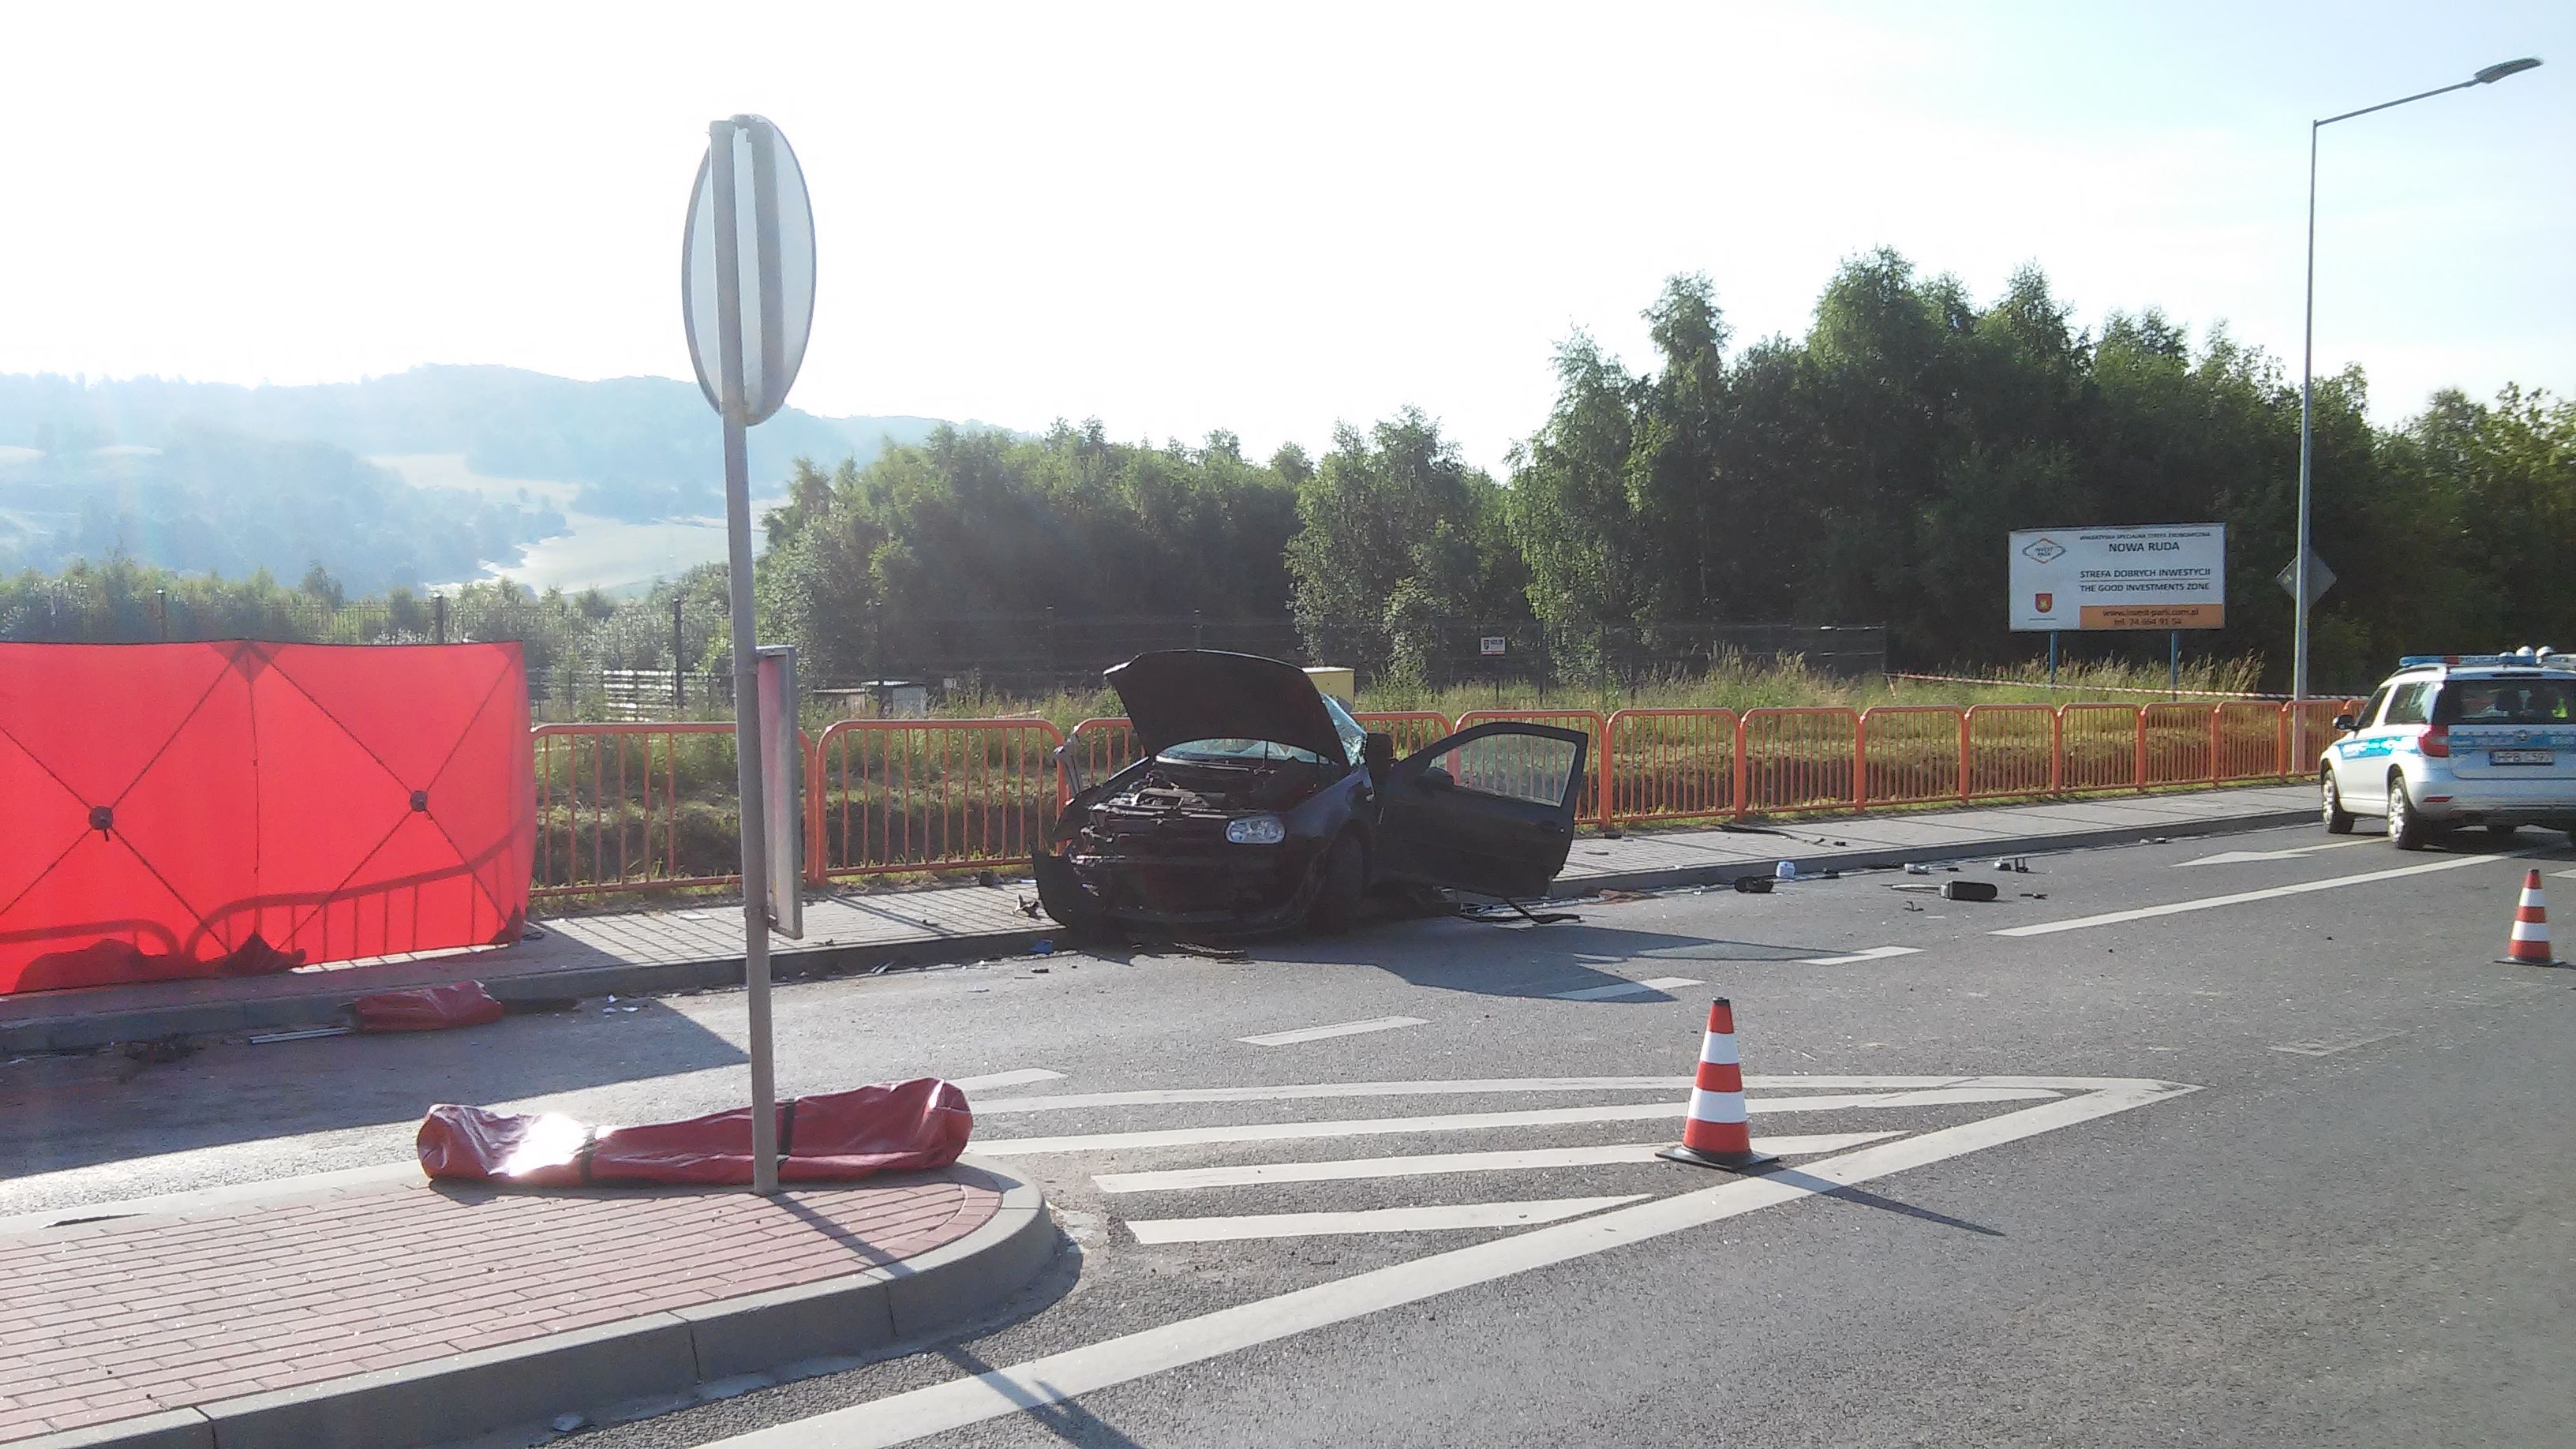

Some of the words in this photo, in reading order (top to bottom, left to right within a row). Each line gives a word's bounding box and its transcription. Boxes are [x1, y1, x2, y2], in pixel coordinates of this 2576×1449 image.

[2108, 543, 2144, 552] NOWA
[2148, 541, 2180, 551] RUDA
[2080, 570, 2111, 578] STREFA
[2114, 569, 2156, 578] DOBRYCH
[2159, 568, 2211, 577] INWESTYCJI
[2126, 583, 2185, 592] INVESTMENTS
